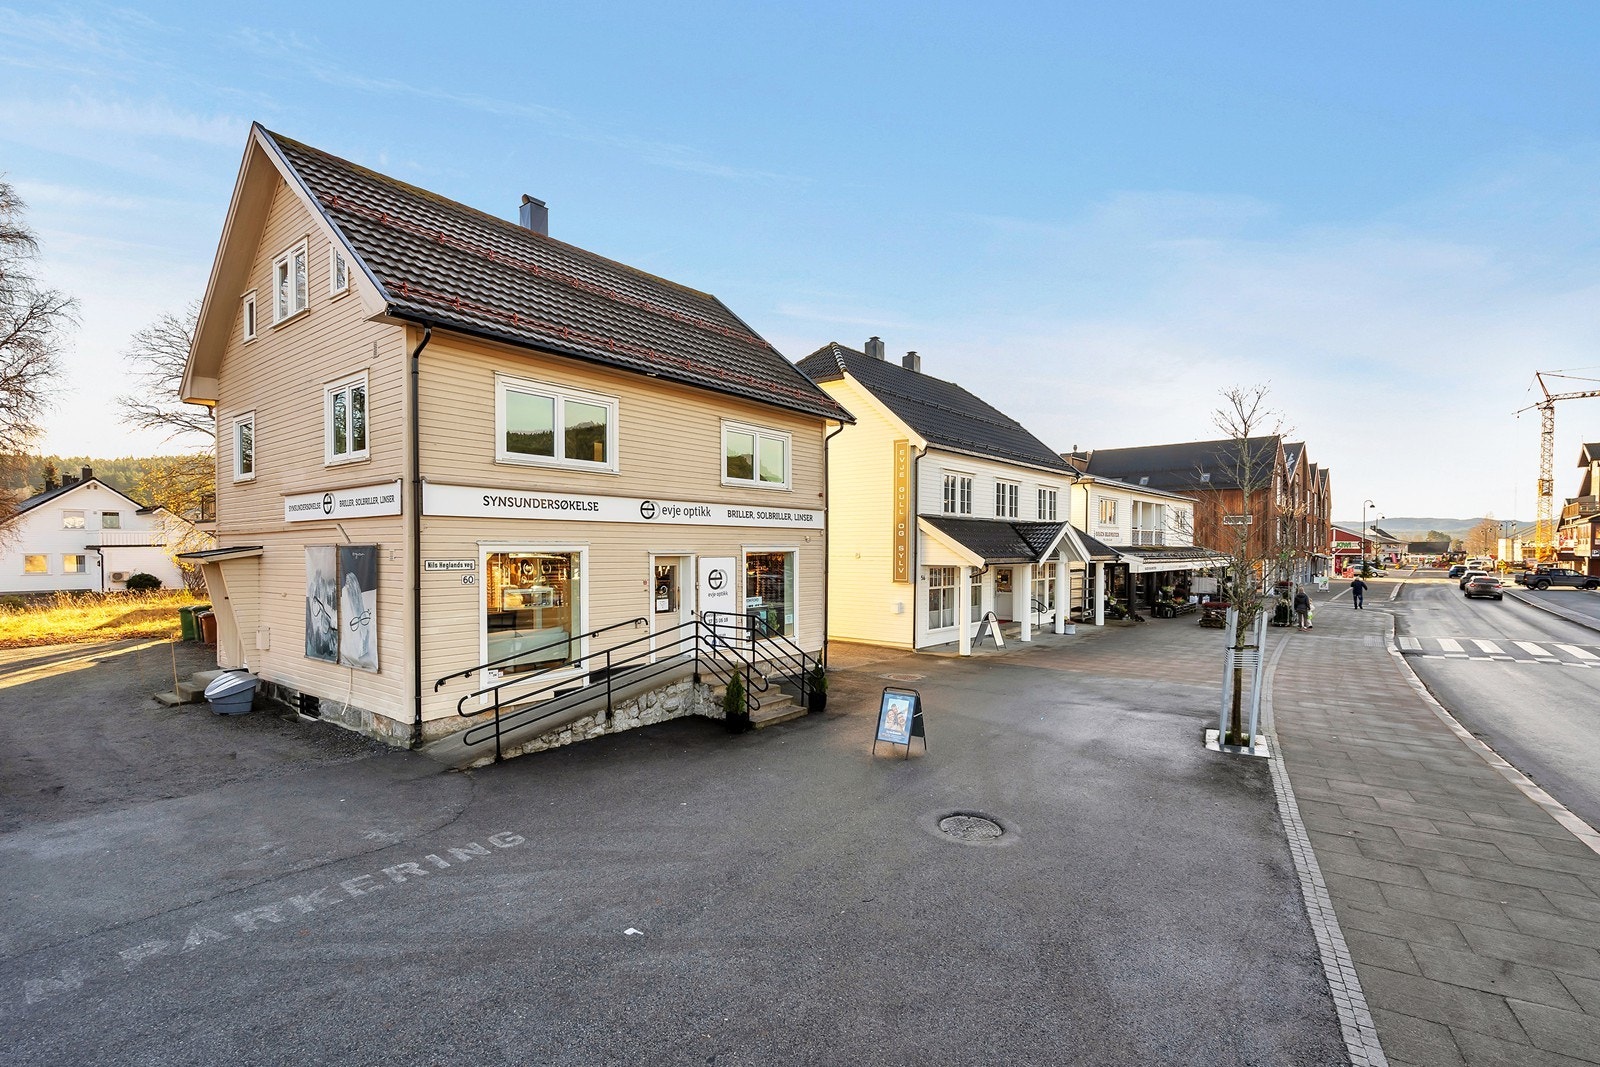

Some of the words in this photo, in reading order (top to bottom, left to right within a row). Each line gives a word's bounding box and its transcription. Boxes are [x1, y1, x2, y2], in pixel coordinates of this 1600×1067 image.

[482, 495, 599, 512] SYNSUNDERSØKELSE
[661, 505, 682, 519] evje
[683, 505, 712, 519] optikk
[727, 509, 756, 520] BRILLER,
[756, 511, 793, 522] SOLBRILLER,
[793, 513, 813, 522] LINSER
[898, 523, 905, 537] OG
[427, 561, 438, 569] Nils
[462, 575, 474, 584] 60
